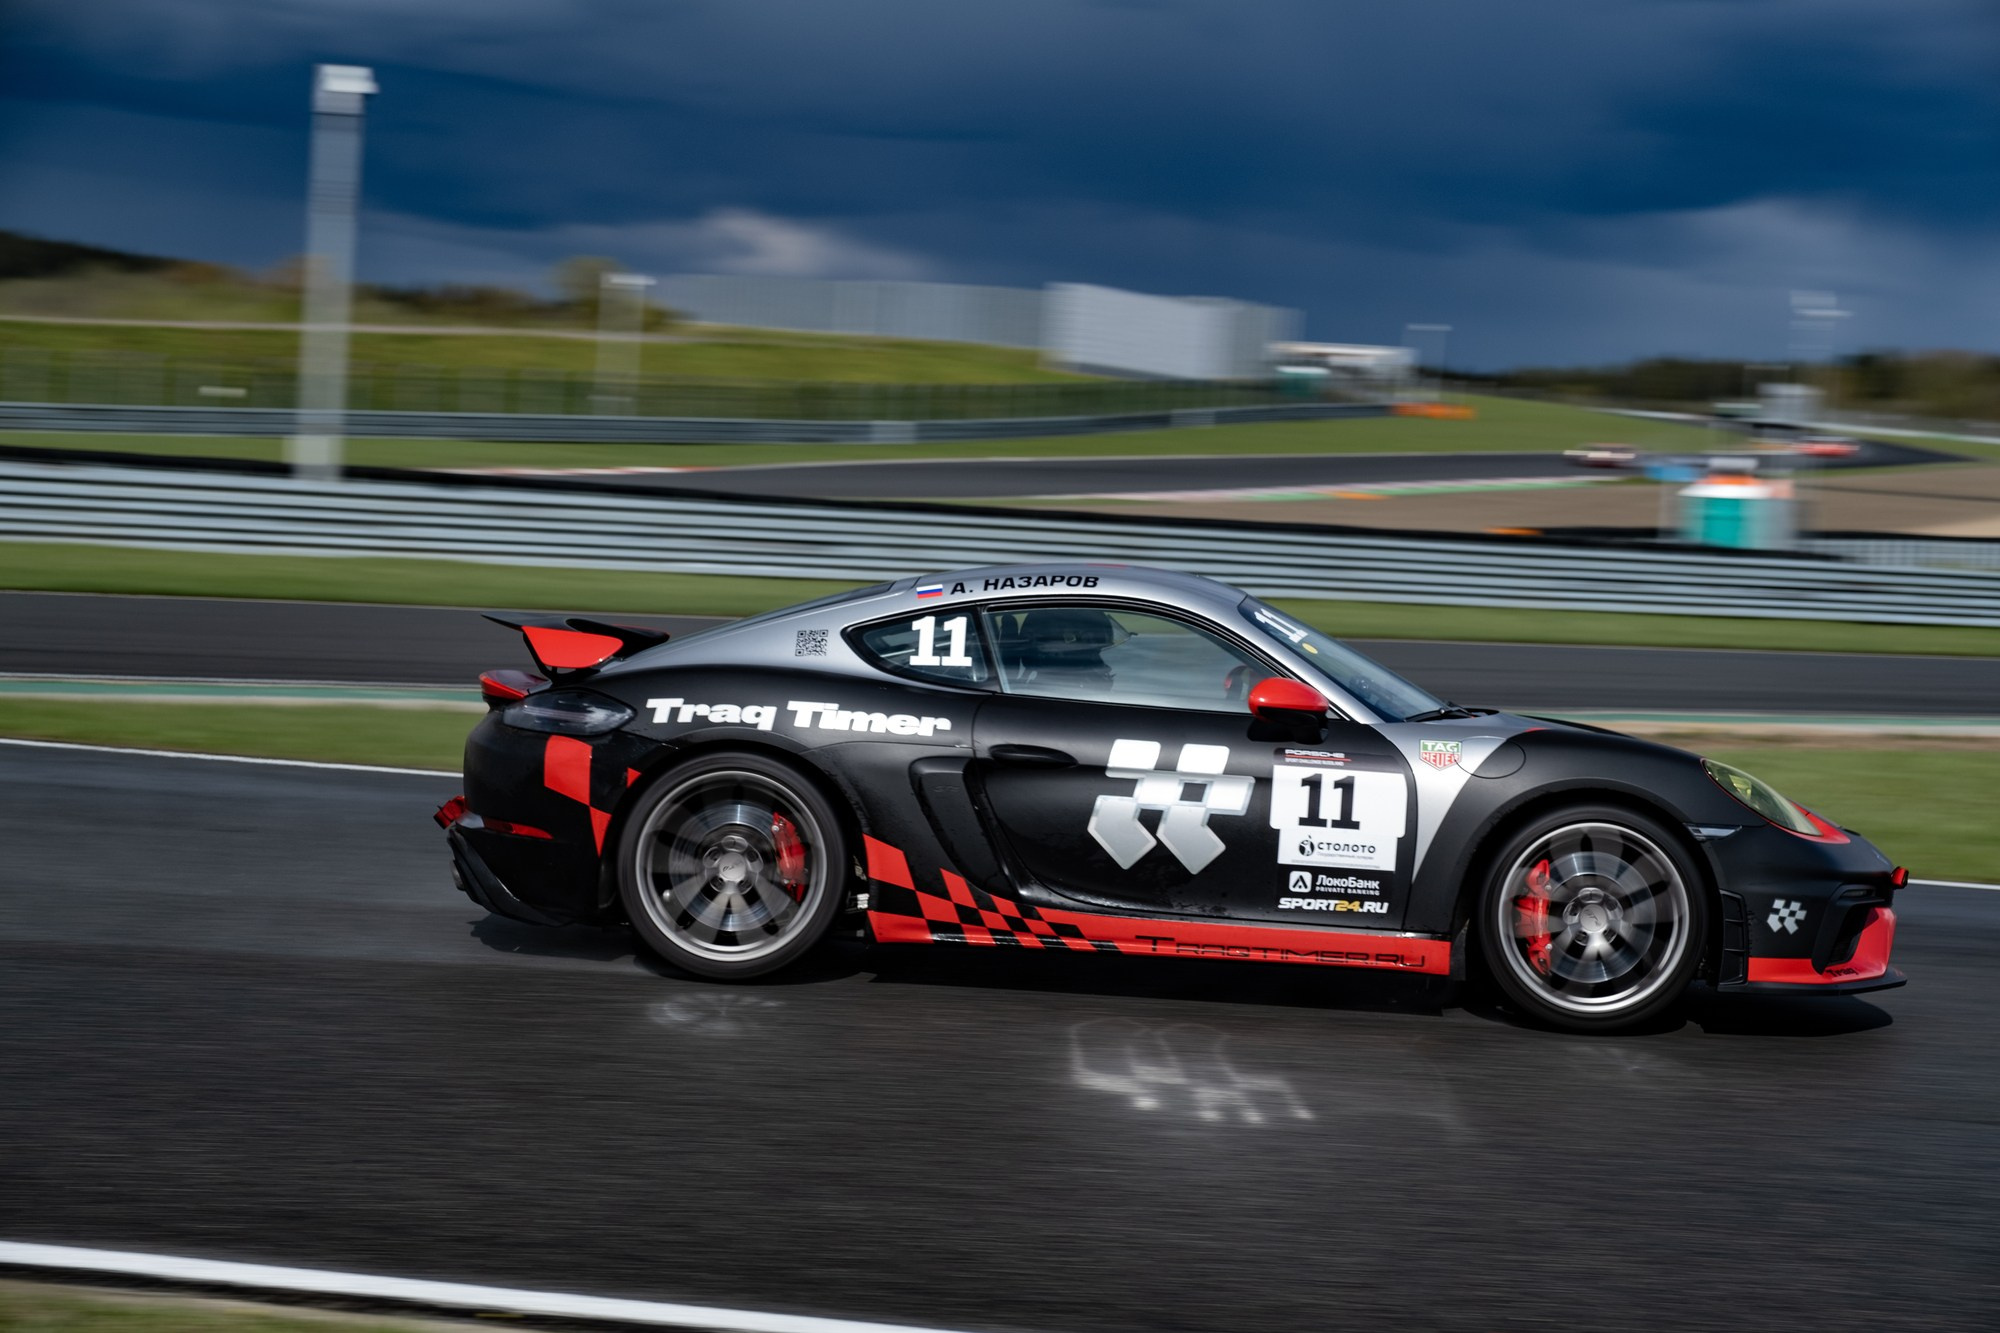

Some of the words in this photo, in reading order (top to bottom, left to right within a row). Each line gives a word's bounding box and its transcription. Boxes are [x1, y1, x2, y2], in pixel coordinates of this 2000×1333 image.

[950, 582, 973, 595] А.
[983, 575, 1100, 591] НАЗАРОВ
[1253, 607, 1309, 644] 11
[909, 615, 973, 667] 11
[645, 697, 777, 731] Traq
[787, 700, 952, 737] Timer
[1284, 749, 1345, 758] PORSCHE
[1423, 742, 1458, 752] TAG
[1422, 752, 1459, 768] HEUER
[1298, 773, 1360, 830] 11
[1317, 842, 1376, 854] СТОЛОТО
[1315, 874, 1380, 890] ЛокоБанк
[1278, 897, 1390, 914] SPORT24.RU
